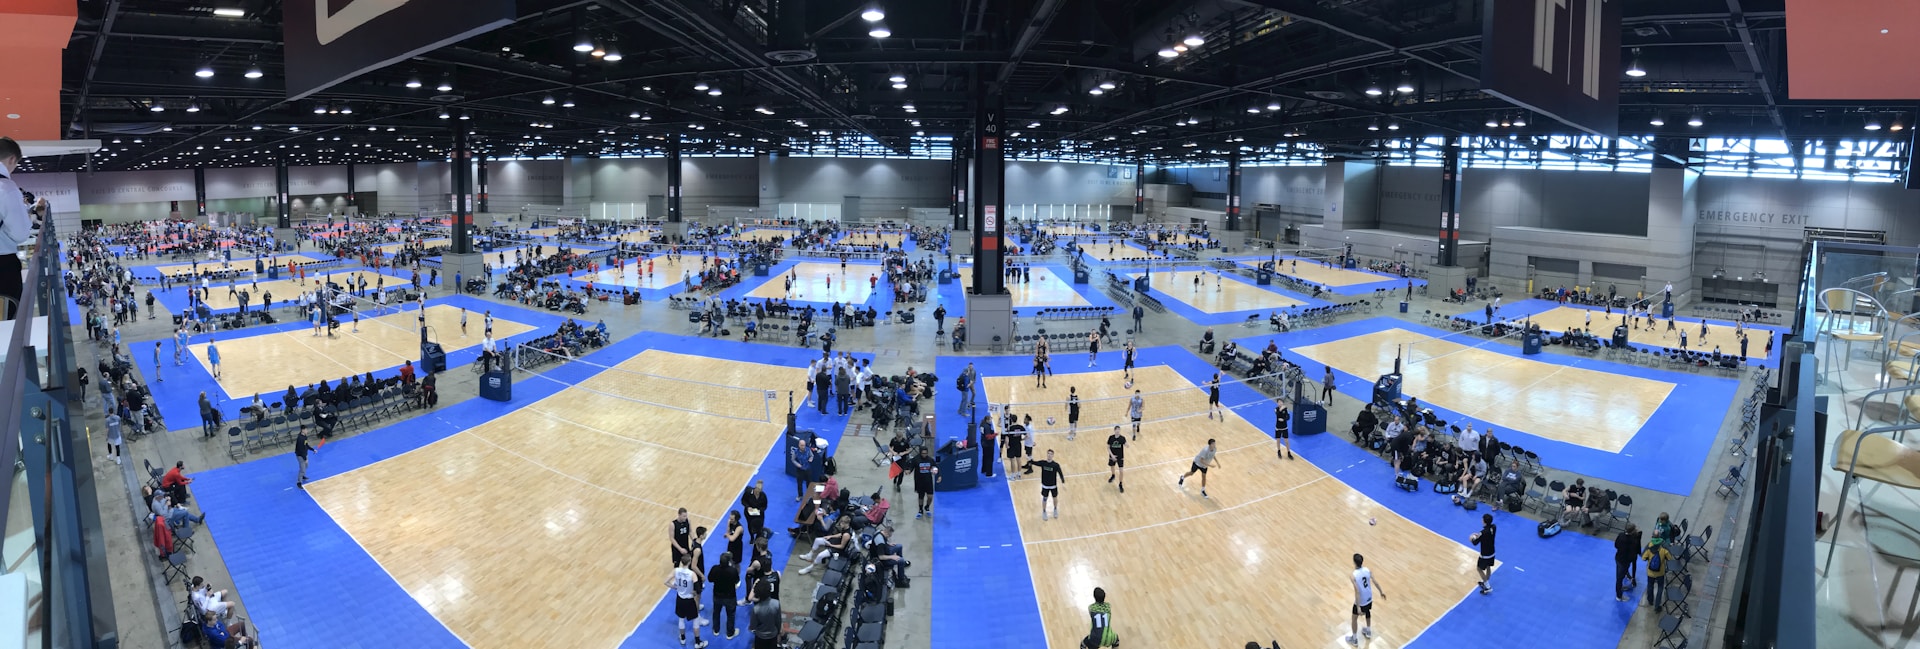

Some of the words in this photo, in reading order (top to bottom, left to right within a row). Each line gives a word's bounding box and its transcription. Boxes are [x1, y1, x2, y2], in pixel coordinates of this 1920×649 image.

[987, 113, 995, 122] V
[985, 124, 997, 133] 40
[1699, 210, 1775, 224] EMERGENCY
[1782, 214, 1810, 225] EXIT
[678, 578, 688, 588] 19
[1362, 577, 1368, 588] 2
[1094, 613, 1109, 628] 11
